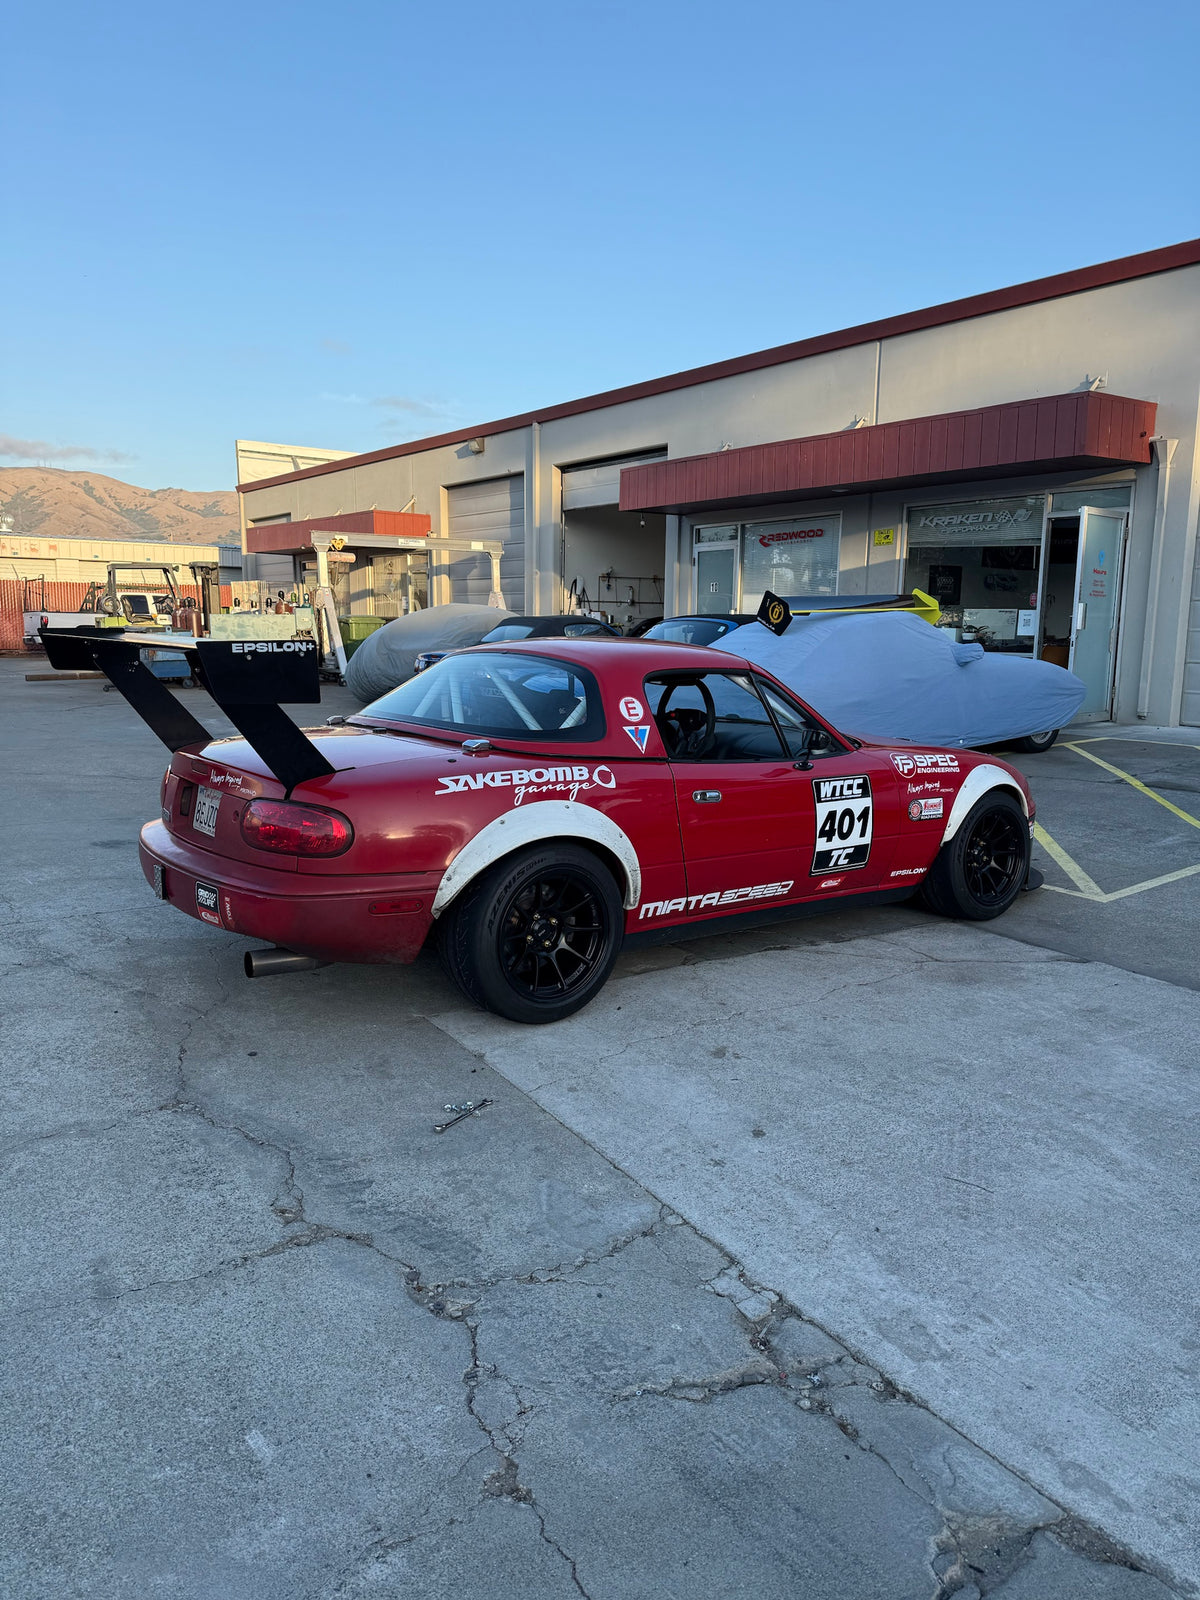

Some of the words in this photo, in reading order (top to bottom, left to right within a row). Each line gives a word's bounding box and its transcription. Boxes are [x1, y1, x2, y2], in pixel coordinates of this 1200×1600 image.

[920, 511, 993, 529] KRAKEN
[767, 528, 824, 543] REDWOOD
[231, 641, 315, 654] EPSILON+
[624, 700, 640, 718] E
[914, 754, 959, 767] SPEC
[434, 765, 590, 796] SAKEBOMB
[820, 778, 863, 798] WTCC
[514, 781, 598, 806] garage
[818, 806, 871, 843] 401
[828, 847, 855, 867] TC
